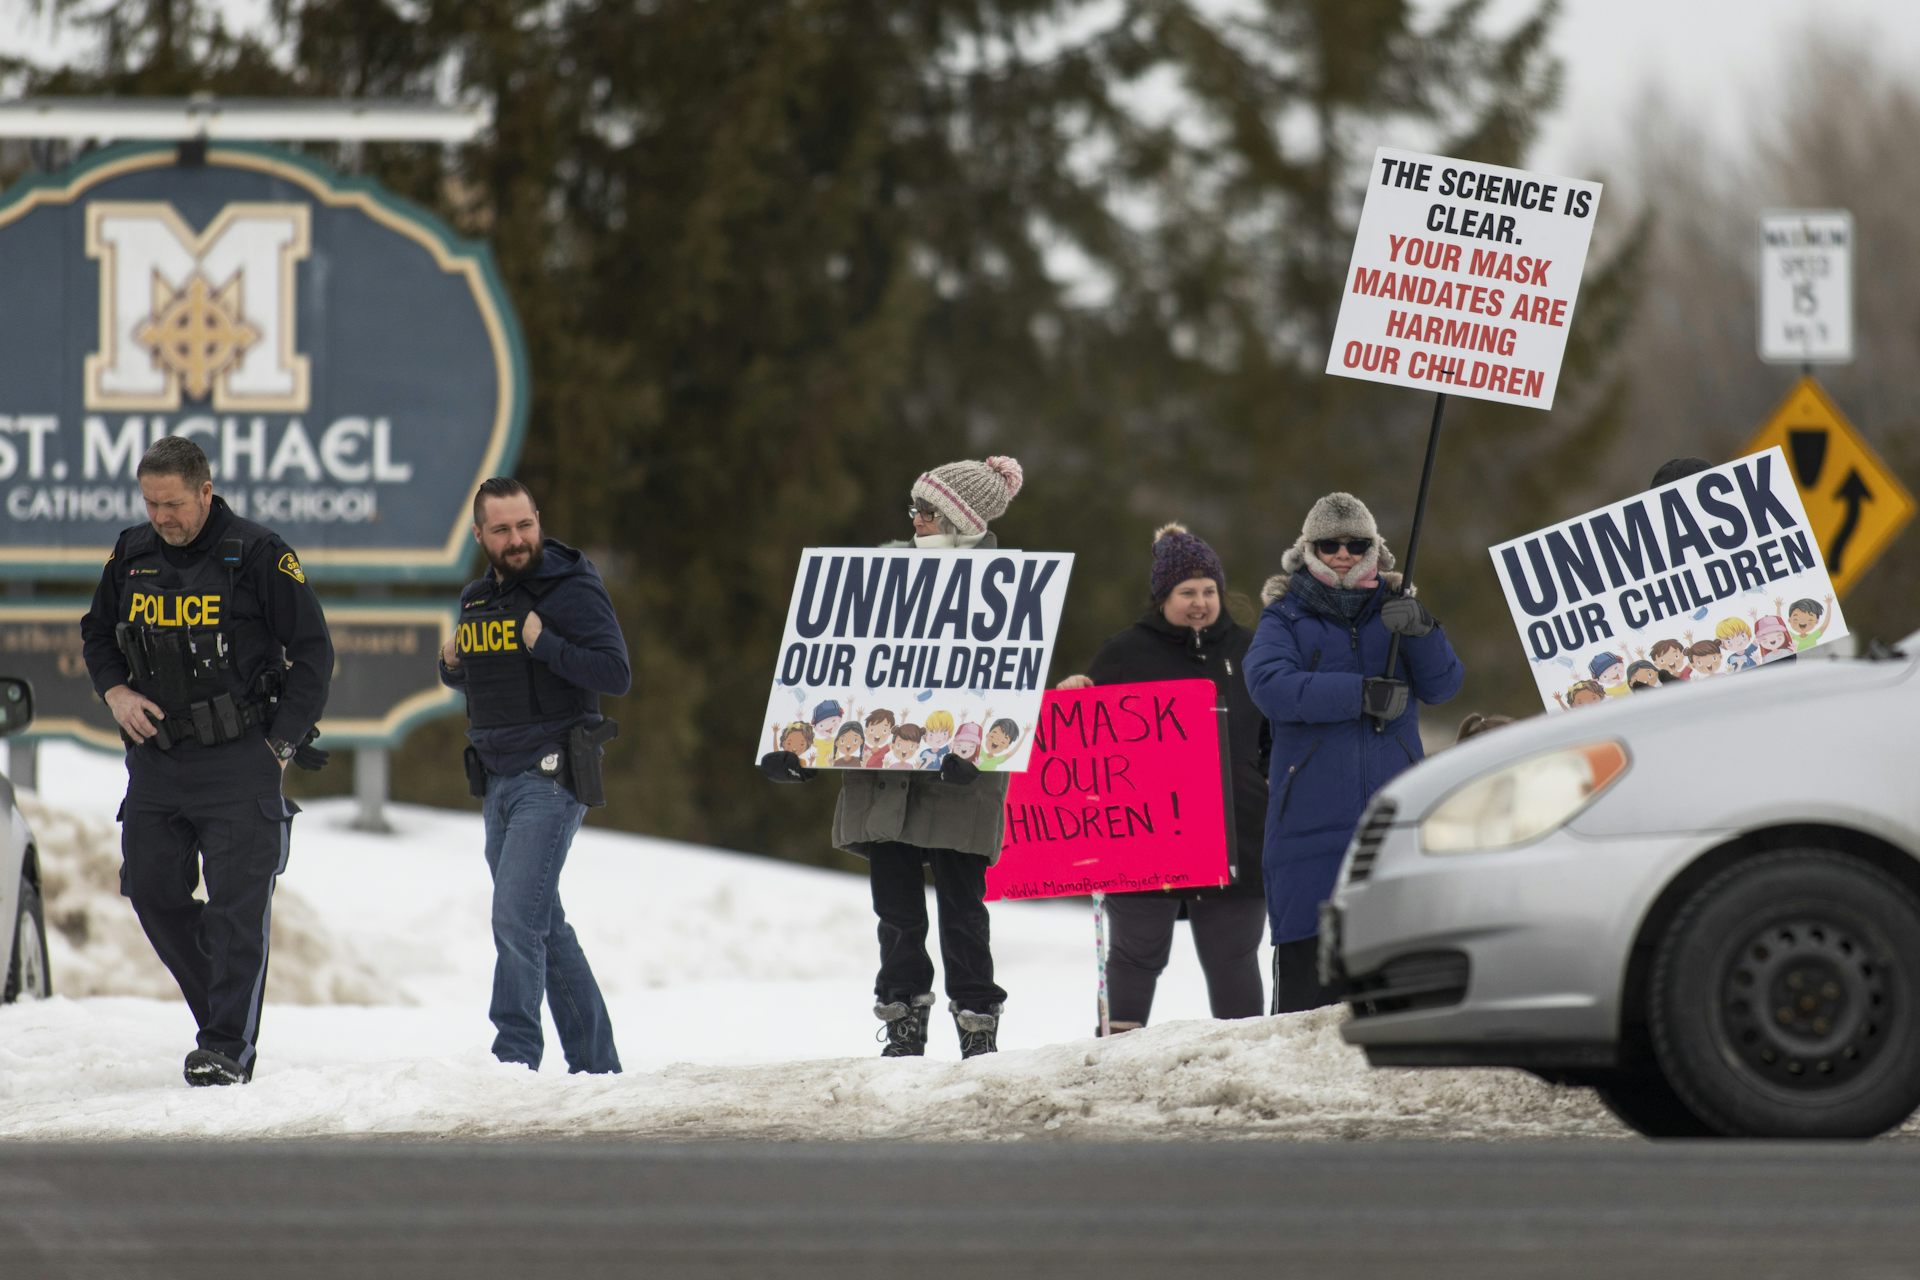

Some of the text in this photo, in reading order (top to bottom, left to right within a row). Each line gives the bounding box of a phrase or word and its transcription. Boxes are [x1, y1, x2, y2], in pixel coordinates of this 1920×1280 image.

[1382, 158, 1592, 218] THE SCIENCE IS
[1426, 204, 1522, 245] CLEAR.
[1389, 234, 1552, 287] YOUR MASK
[1352, 267, 1567, 327] MANDATES ARE
[1386, 310, 1517, 356] HARMING
[1343, 341, 1545, 398] OUR CHILDREN
[6, 487, 148, 522] CATHOLI
[1501, 454, 1797, 617] UNMASK
[128, 592, 221, 626] POLICE
[796, 556, 1060, 642] UNMASK
[1527, 530, 1816, 661] OUR CHILDREN
[455, 620, 518, 654] POLICE
[781, 642, 1044, 690] OUR CHILDREN
[1041, 754, 1136, 797] OUR
[1001, 802, 1155, 851] HILDREN
